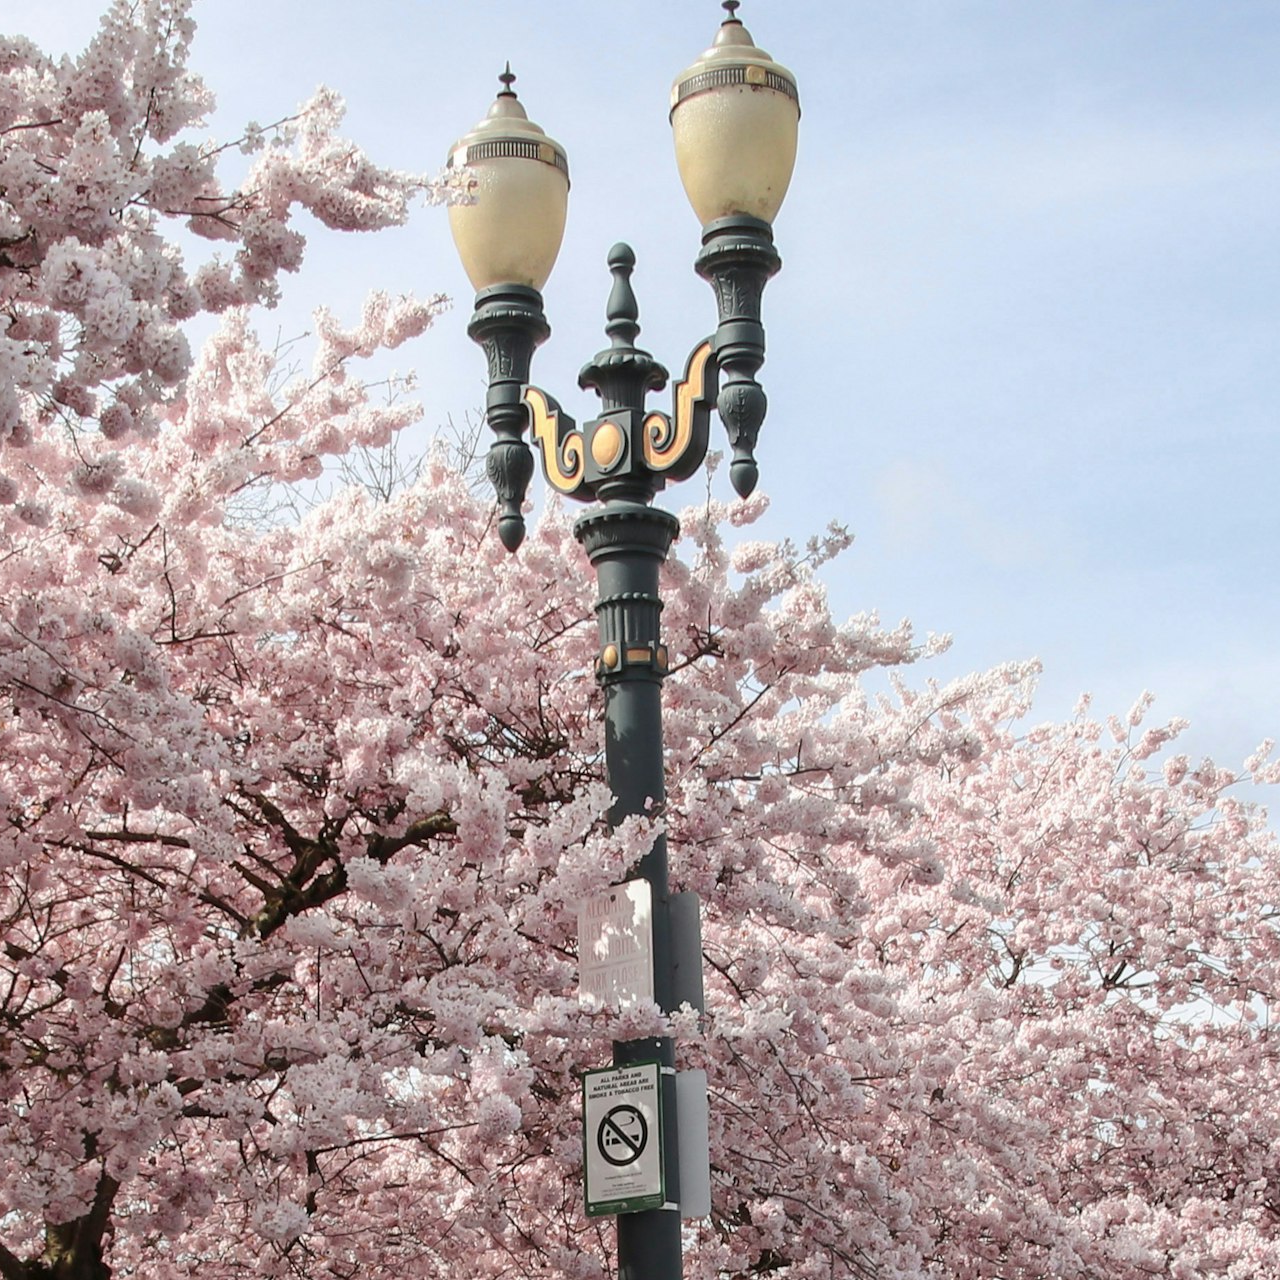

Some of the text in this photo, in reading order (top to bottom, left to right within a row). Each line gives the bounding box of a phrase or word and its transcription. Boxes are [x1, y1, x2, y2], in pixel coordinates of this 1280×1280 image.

[593, 1083, 618, 1092] NATURAL
[589, 1092, 607, 1100] SMOKE
[614, 1087, 640, 1096] TOBACCO
